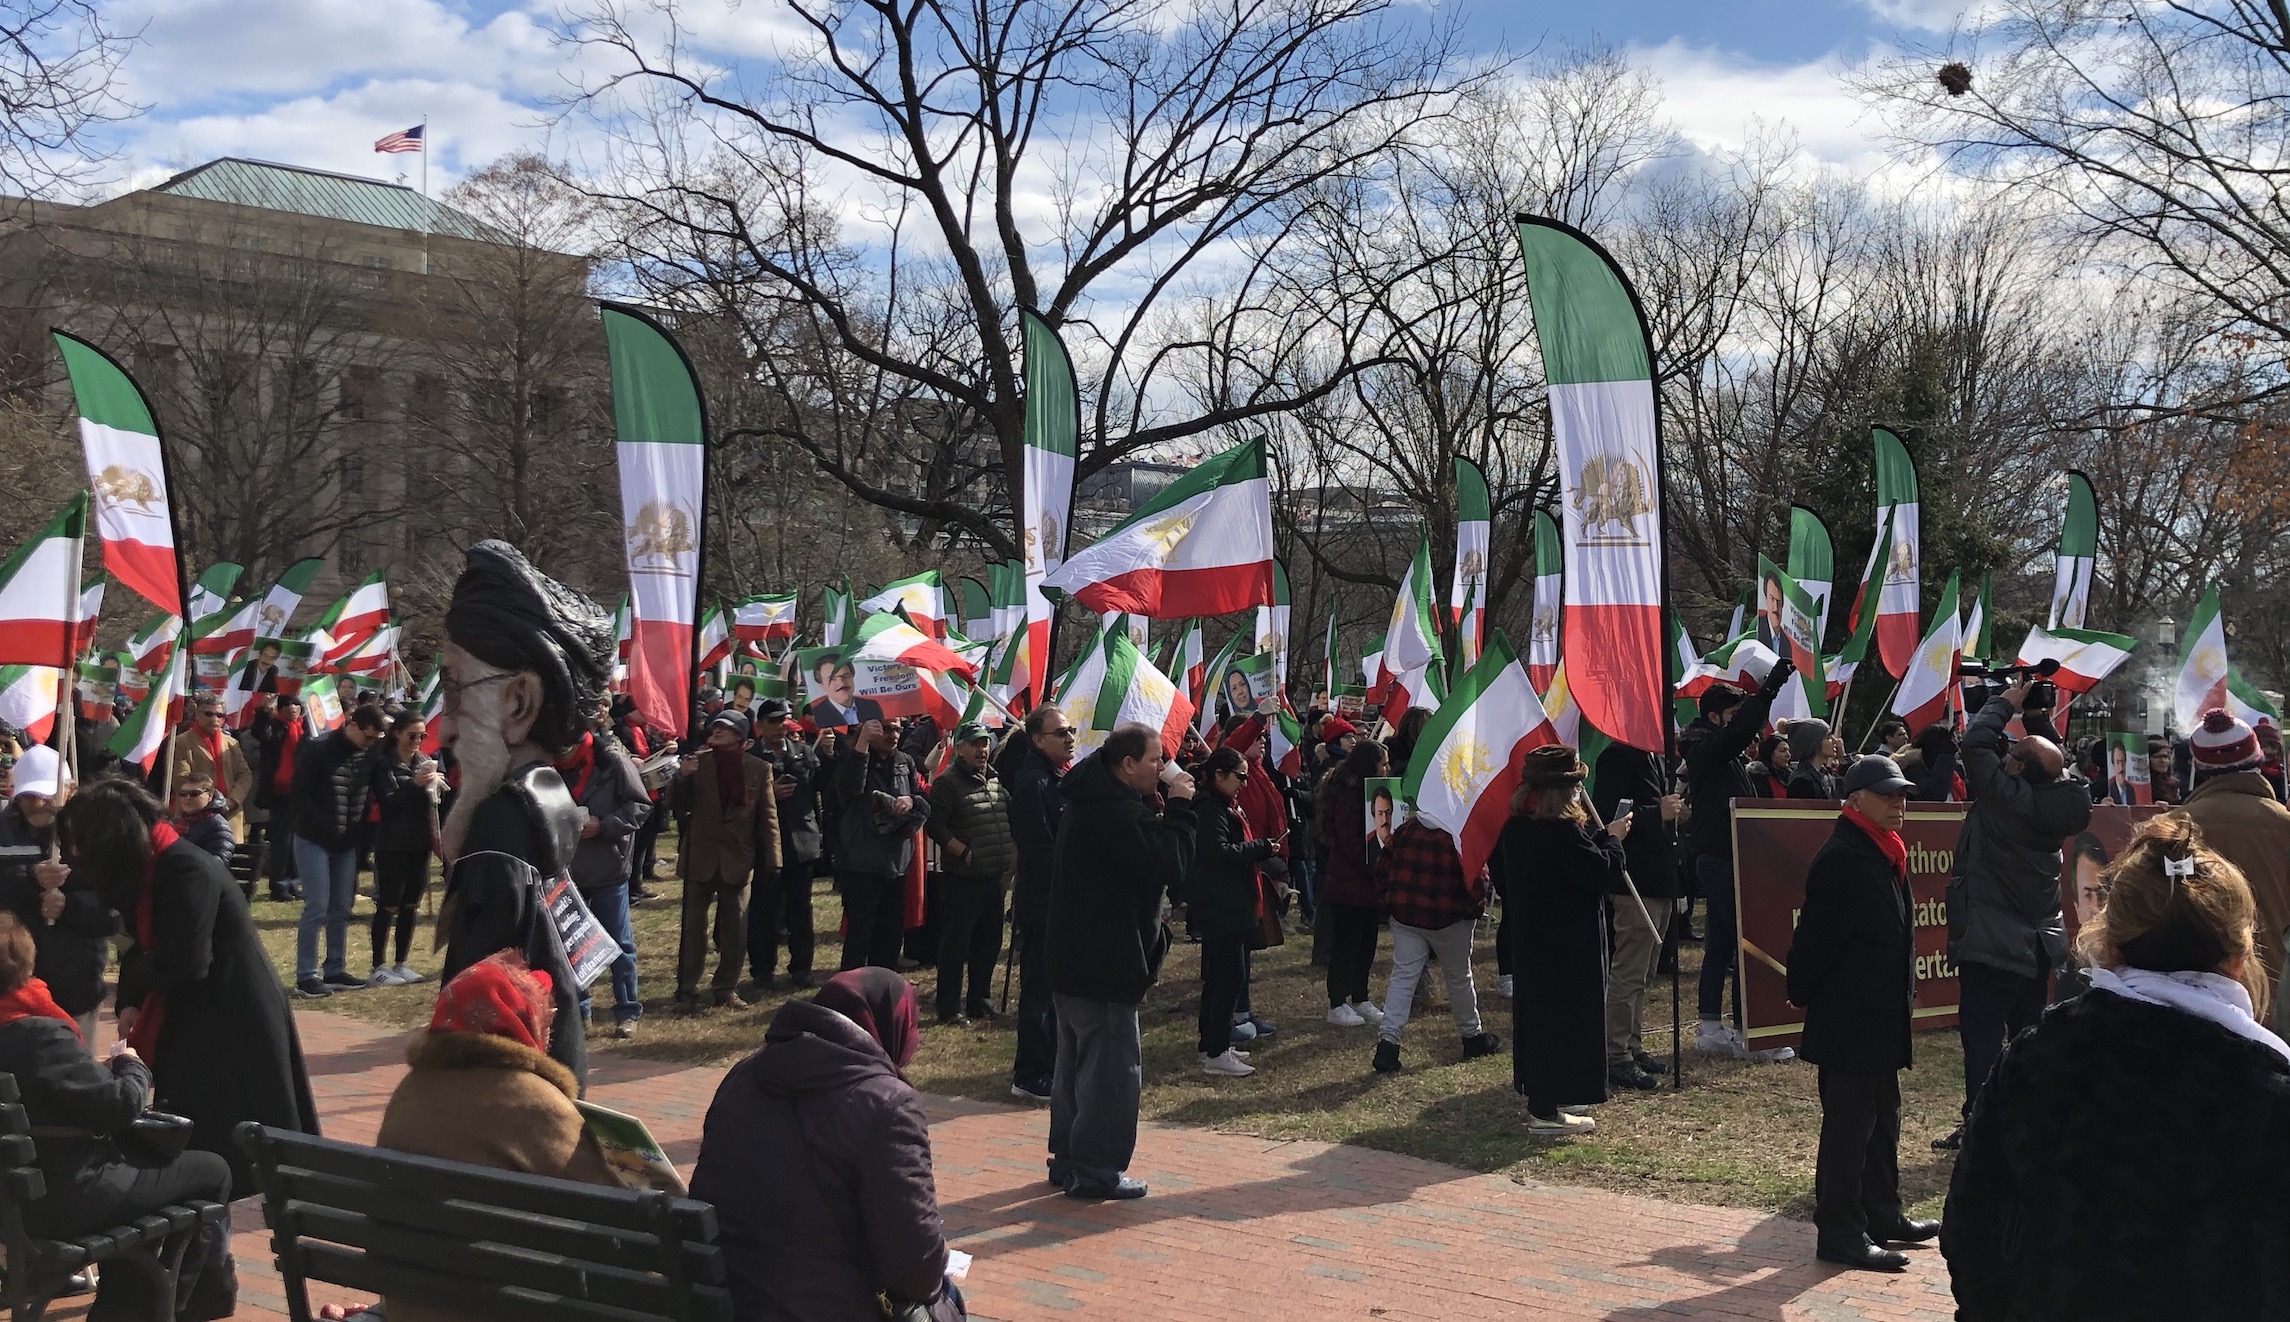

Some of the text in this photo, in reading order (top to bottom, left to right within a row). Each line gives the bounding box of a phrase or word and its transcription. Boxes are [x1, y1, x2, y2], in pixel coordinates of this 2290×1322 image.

[867, 663, 902, 673] Victory
[873, 672, 915, 682] Freedom
[858, 687, 878, 696] Will
[895, 683, 917, 691] Ours
[564, 934, 576, 953] per
[574, 920, 593, 940] capita
[578, 961, 588, 980] of
